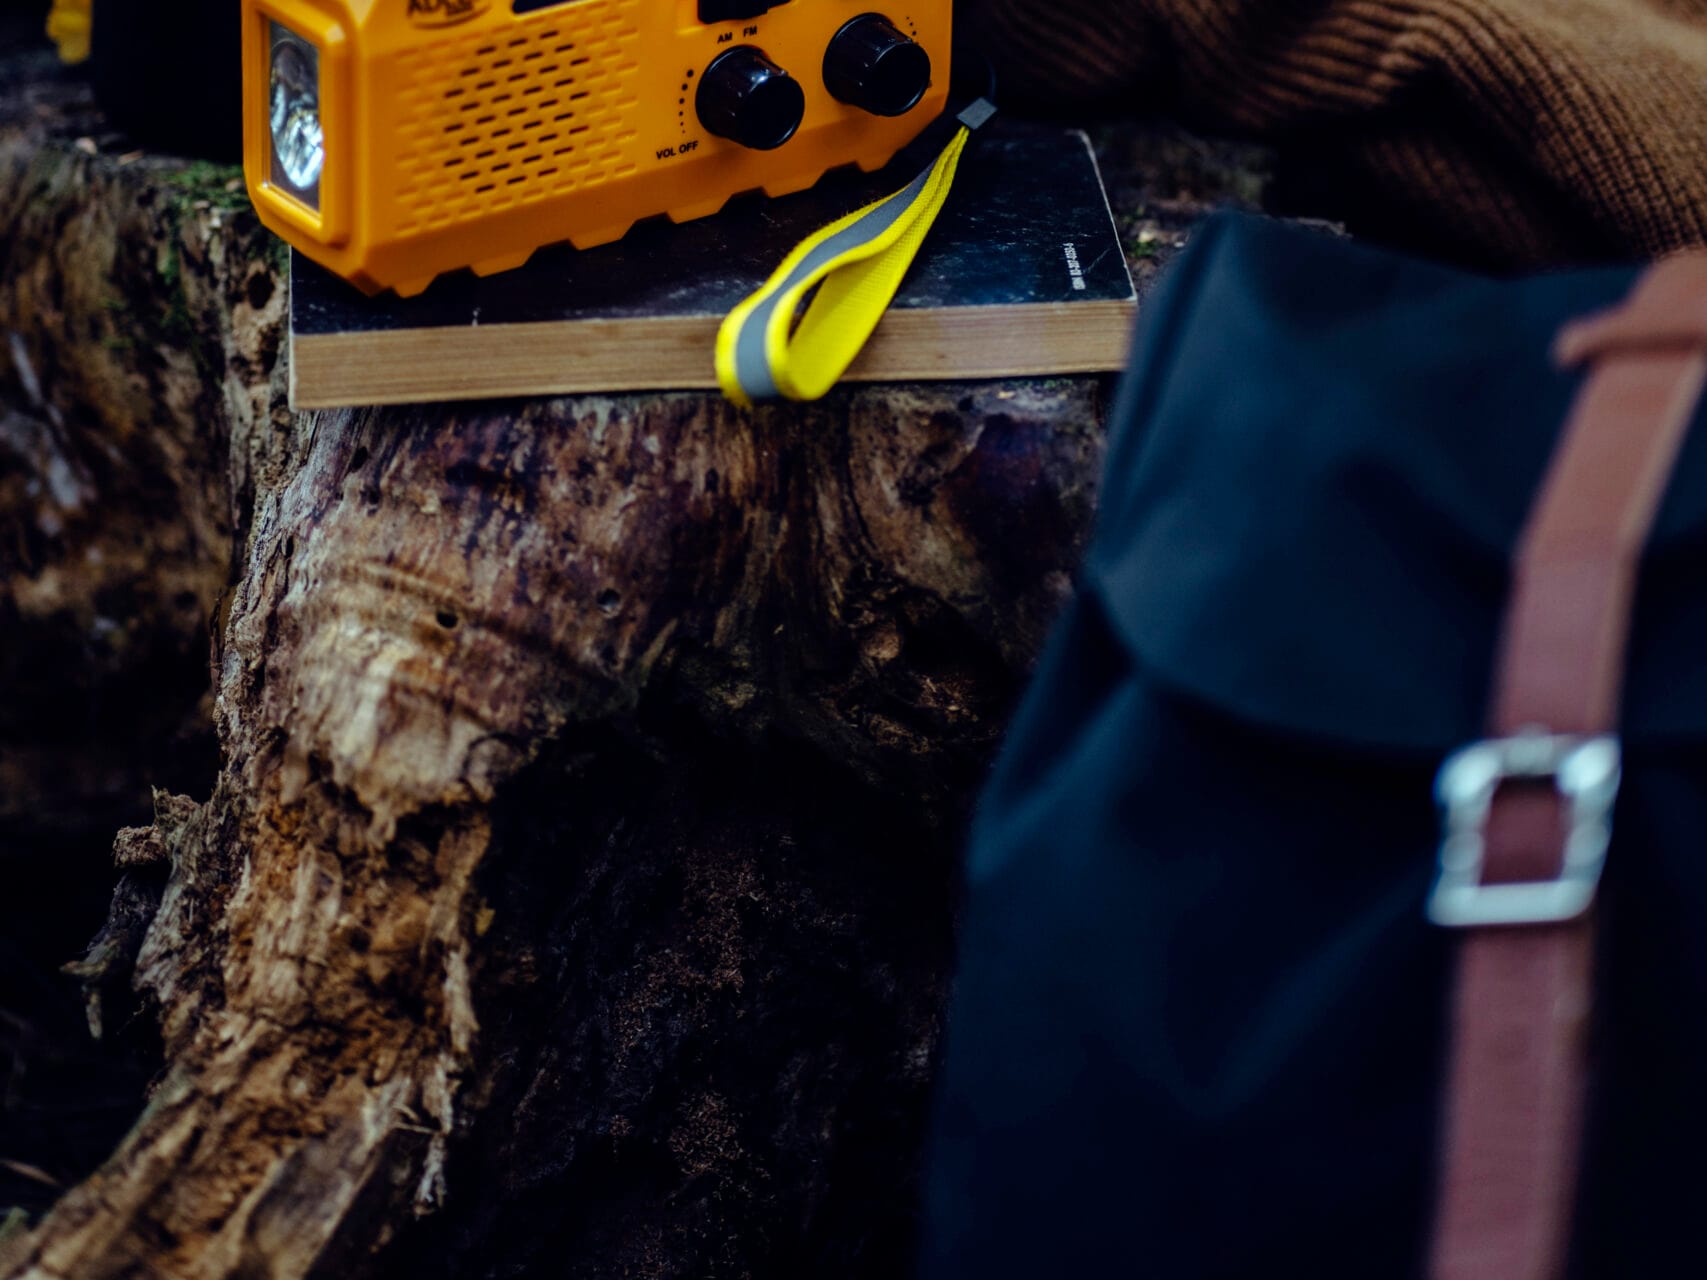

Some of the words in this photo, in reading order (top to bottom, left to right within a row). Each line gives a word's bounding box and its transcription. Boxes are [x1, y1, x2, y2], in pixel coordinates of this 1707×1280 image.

[717, 32, 733, 44] AM
[743, 26, 758, 38] FM
[656, 147, 676, 160] VOL
[678, 140, 699, 154] OFF
